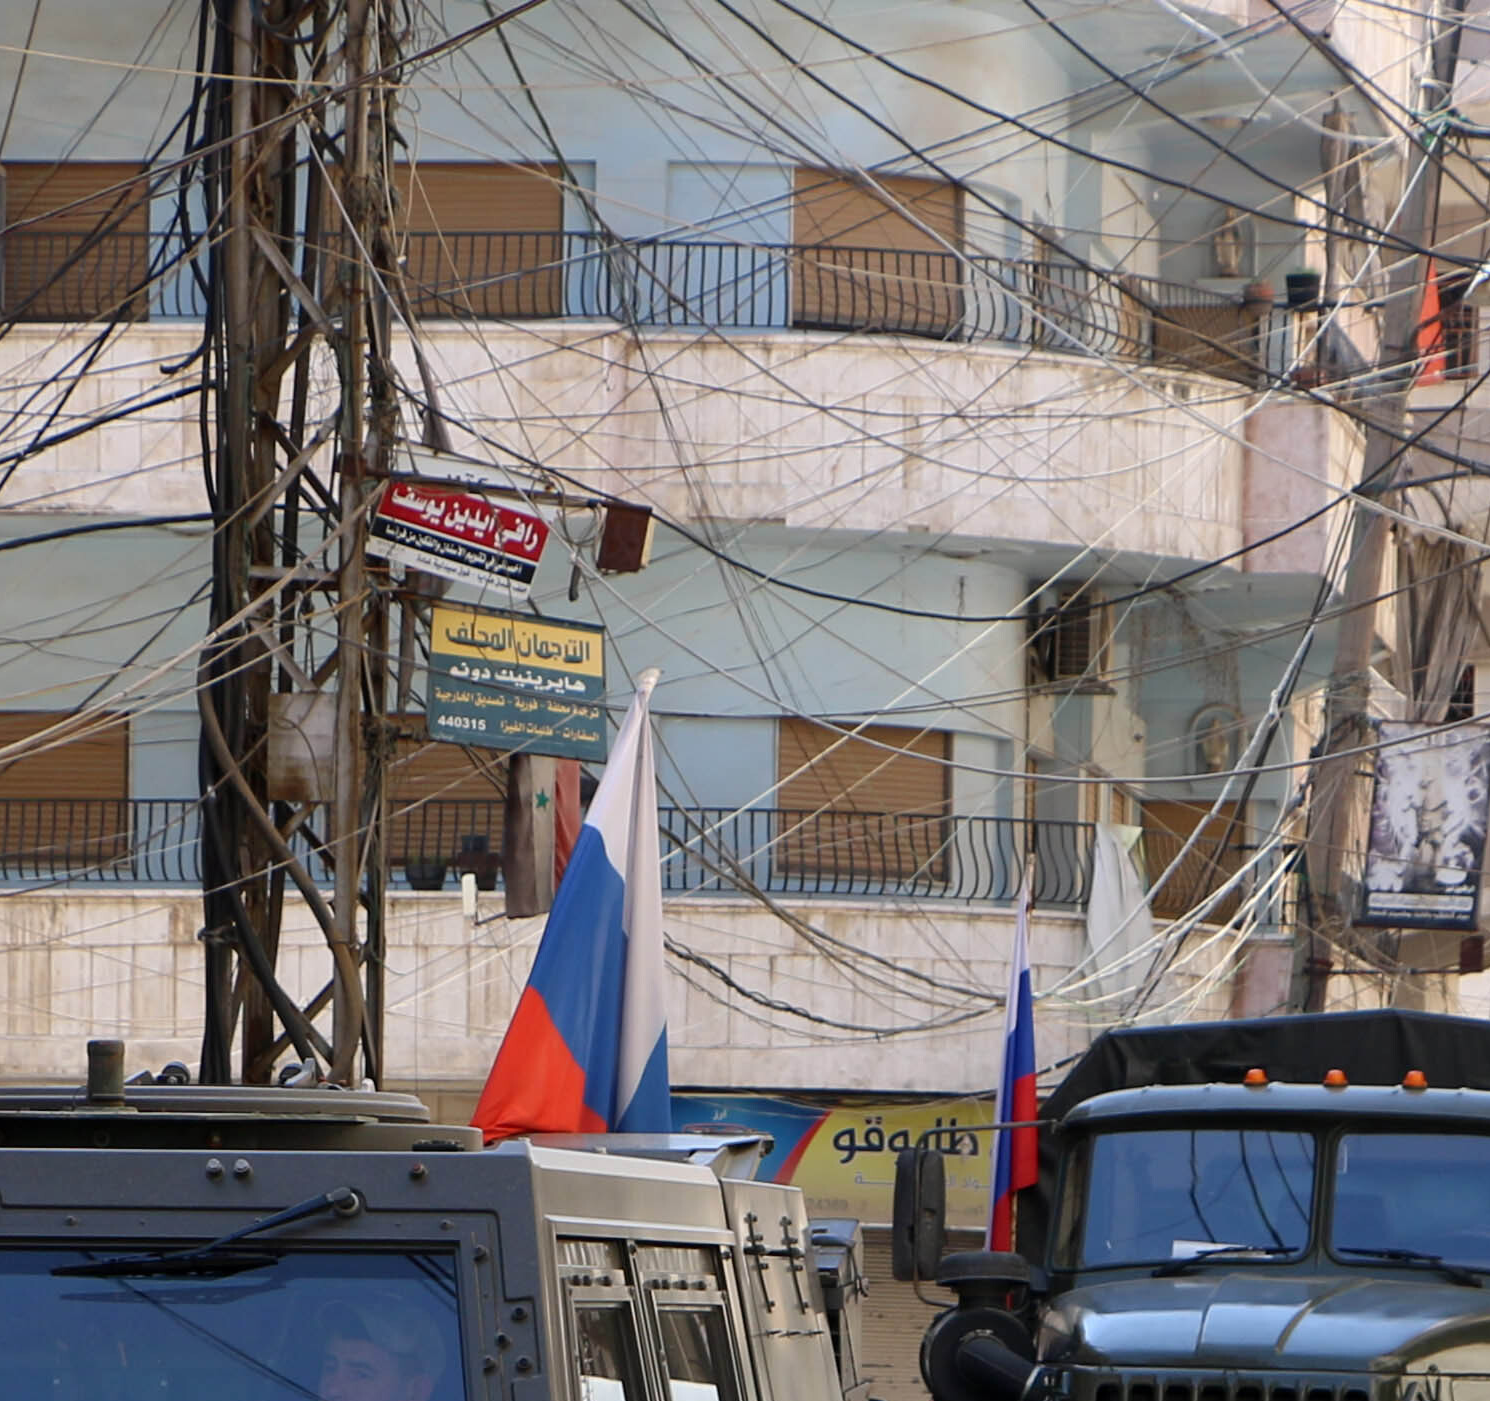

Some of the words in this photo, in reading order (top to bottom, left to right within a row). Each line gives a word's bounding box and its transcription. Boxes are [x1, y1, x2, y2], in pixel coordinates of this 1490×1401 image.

[392, 484, 446, 525] يوسف
[494, 517, 539, 552] رافي
[446, 622, 512, 651] المحلف
[518, 630, 590, 663] الترجمان
[514, 696, 539, 712] فورية
[438, 715, 487, 731] 440315
